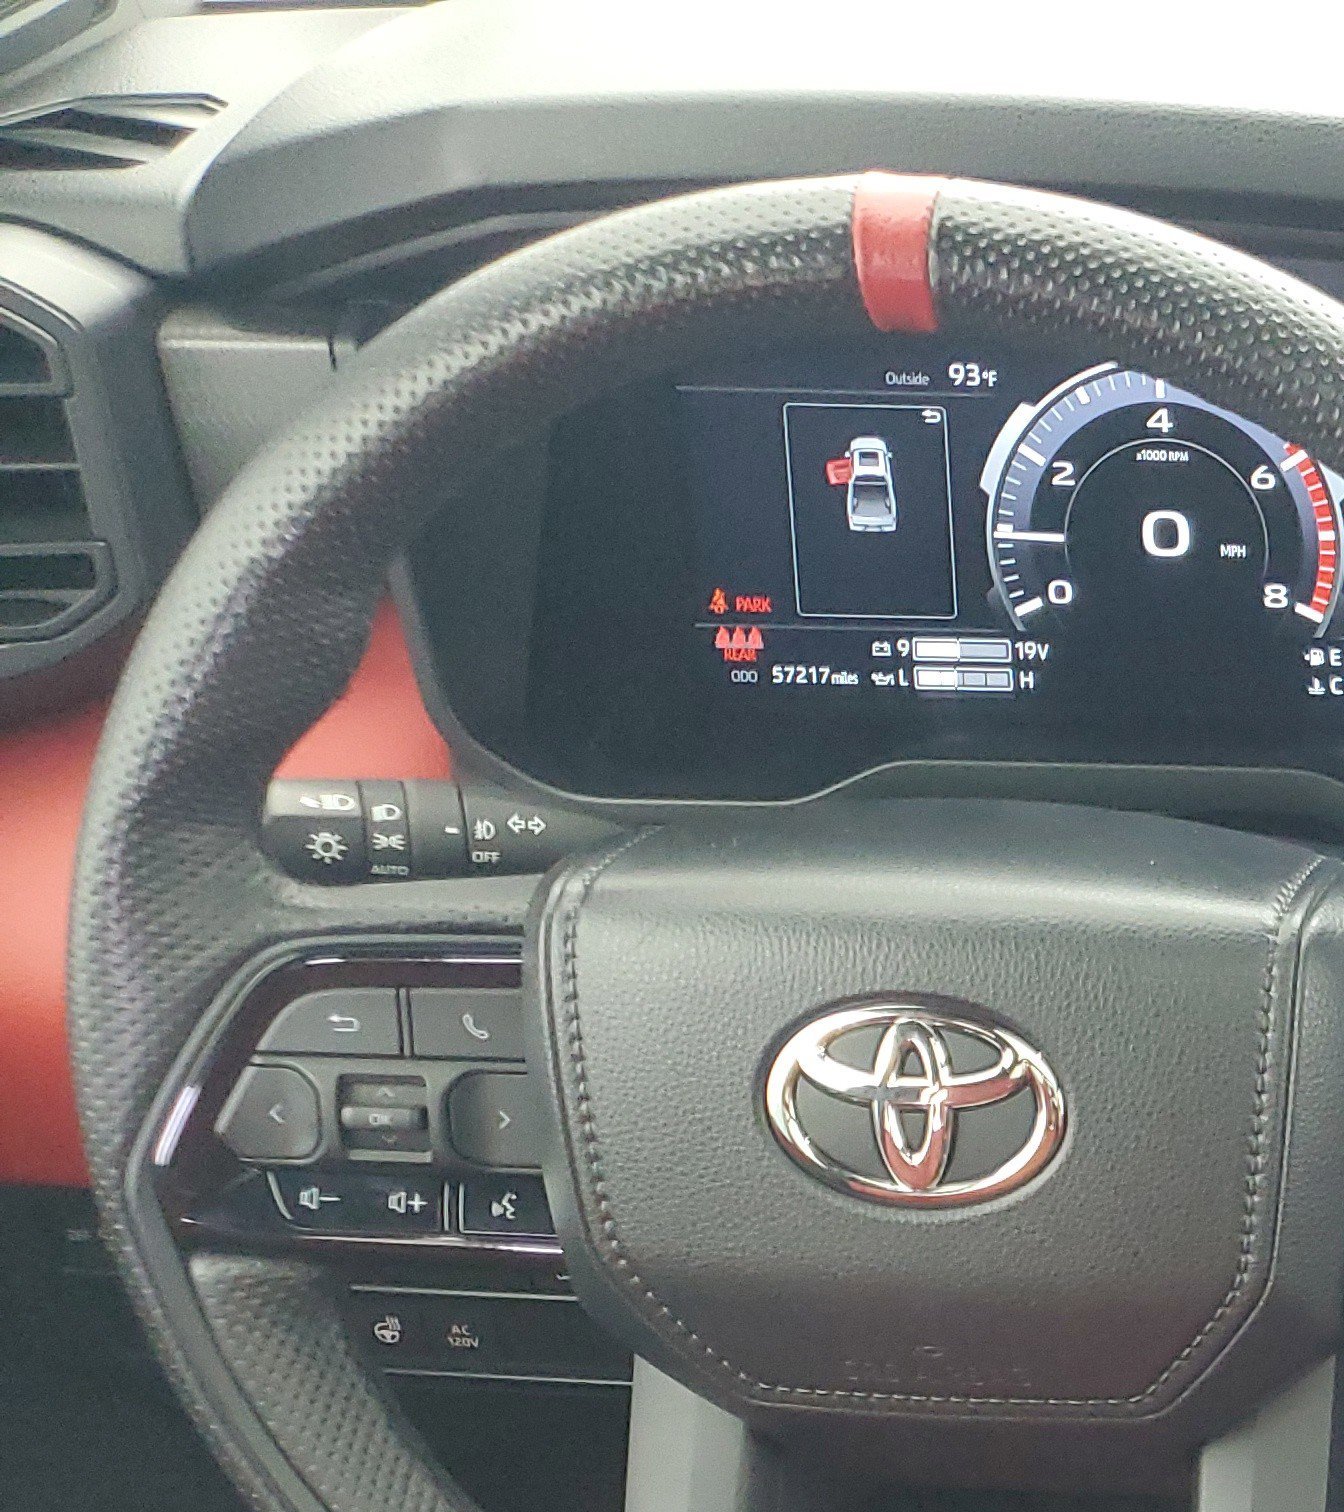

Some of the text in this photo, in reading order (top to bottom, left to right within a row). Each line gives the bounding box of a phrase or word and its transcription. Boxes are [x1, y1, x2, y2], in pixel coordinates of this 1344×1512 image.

[885, 371, 931, 387] Outside
[1146, 407, 1174, 433] 4
[1168, 451, 1189, 462] RPM
[1051, 461, 1076, 487] 2
[1250, 464, 1276, 490] 6
[1141, 509, 1247, 558] 0 MPH
[1047, 580, 1073, 605] 0
[1263, 582, 1289, 608] 8
[734, 595, 772, 613] PARK
[898, 640, 1050, 660] 9 19V
[1329, 647, 1343, 667] E
[730, 670, 758, 683] ODO
[771, 664, 831, 686] 57217
[898, 667, 1035, 689] L H
[1329, 677, 1343, 696] C
[471, 850, 501, 863] OFF
[370, 864, 409, 877] AUTO
